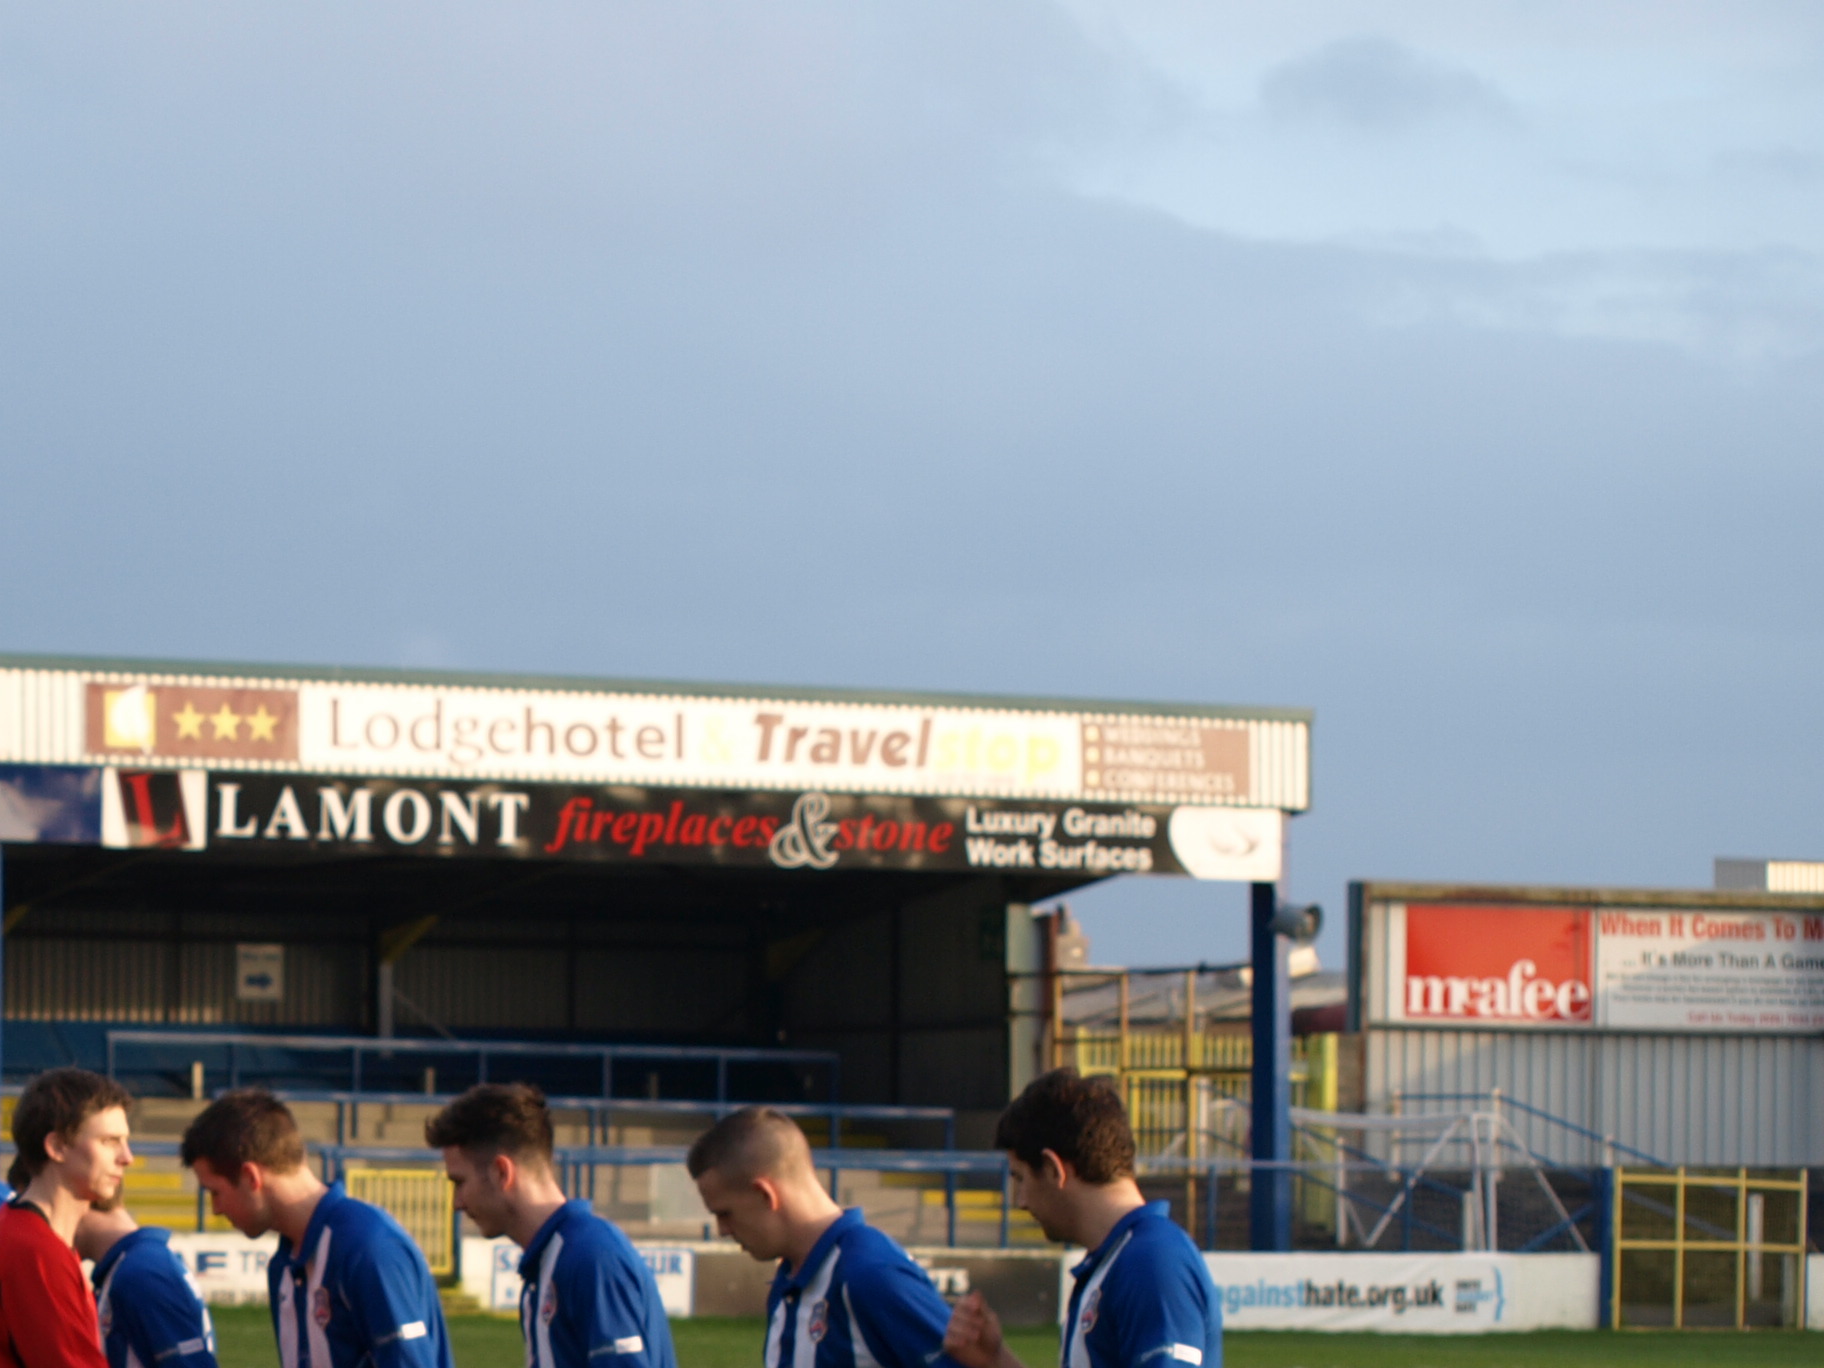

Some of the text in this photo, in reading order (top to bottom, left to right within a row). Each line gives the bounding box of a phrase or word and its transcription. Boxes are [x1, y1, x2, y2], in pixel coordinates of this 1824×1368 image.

[216, 783, 530, 847] LAMONT
[965, 807, 1157, 839] Luxury Granite
[965, 839, 1153, 872] Work Surfaces
[1600, 912, 1661, 937] When
[1692, 914, 1766, 941] Comes
[1772, 915, 1796, 940] To
[1673, 951, 1714, 968] More
[1719, 952, 1760, 970] Than
[1765, 953, 1776, 969] A
